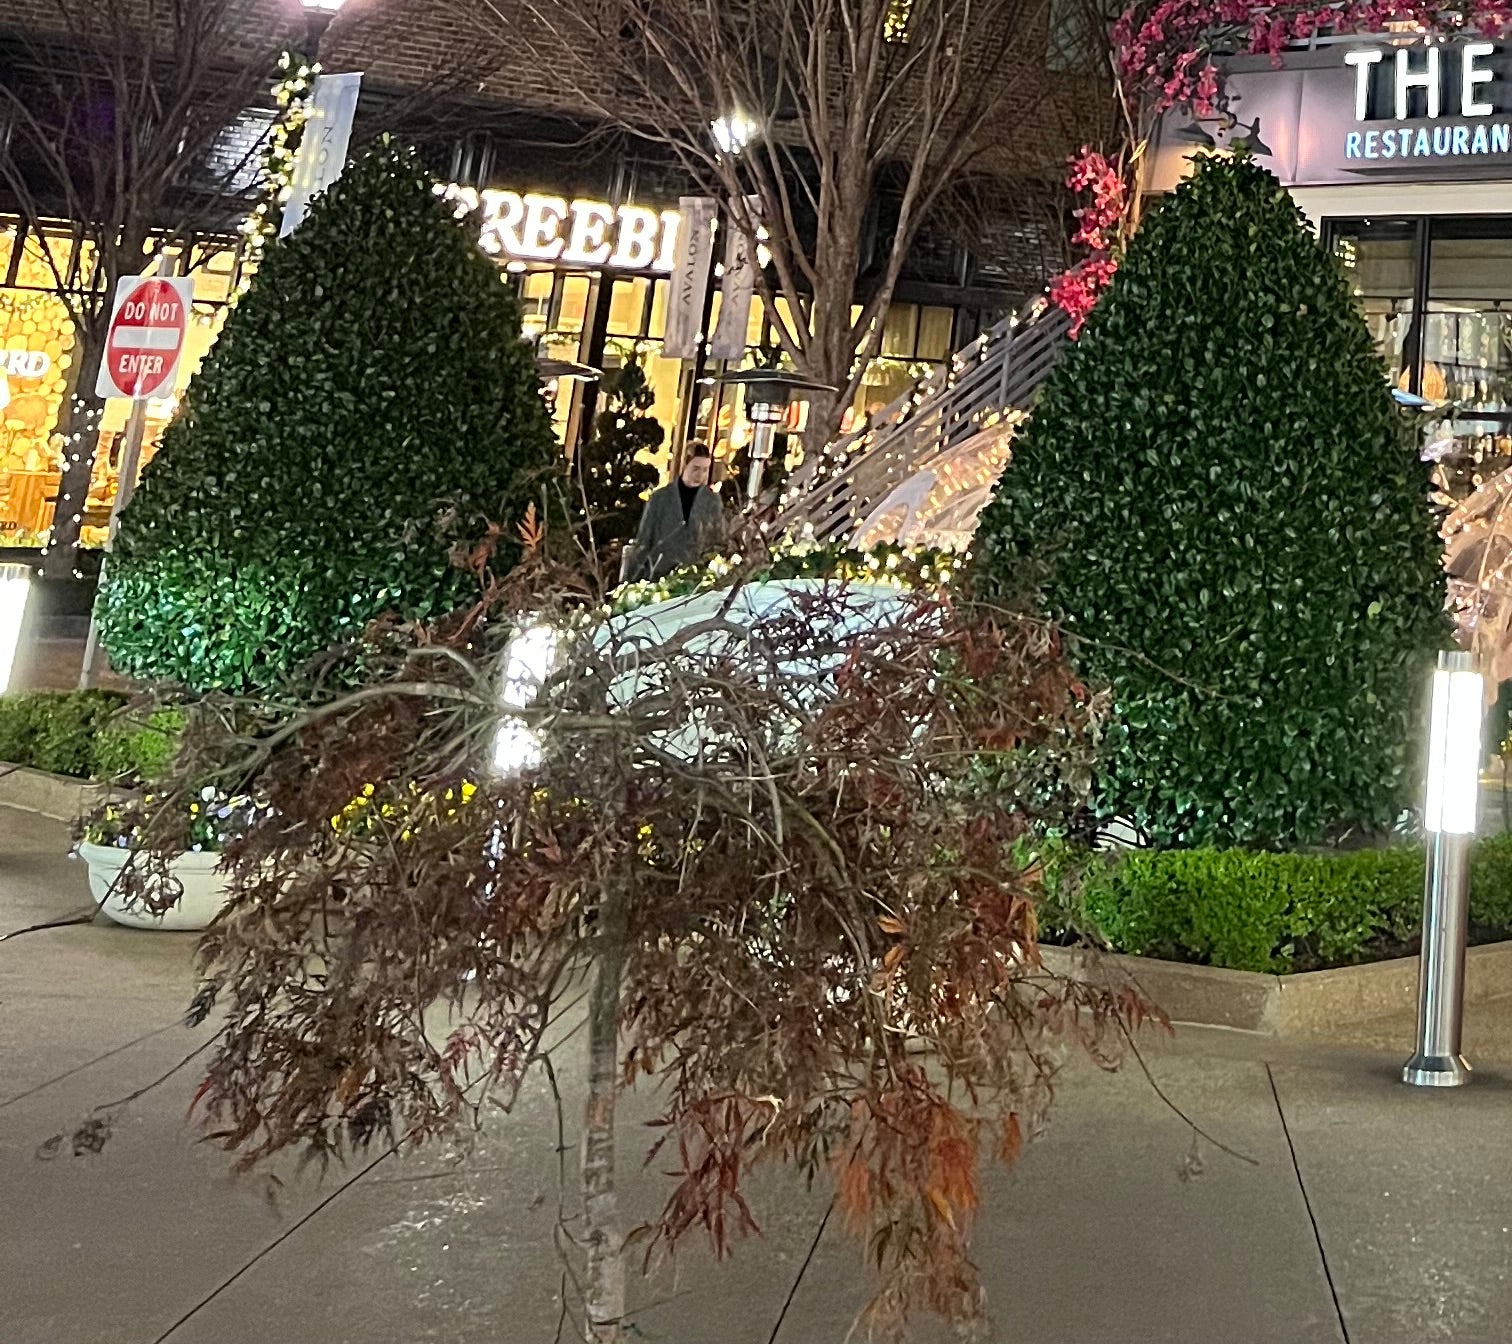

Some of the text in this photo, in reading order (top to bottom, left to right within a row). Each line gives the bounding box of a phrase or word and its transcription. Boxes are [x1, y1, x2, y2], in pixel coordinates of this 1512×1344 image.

[1345, 42, 1494, 121] THE
[433, 183, 681, 272] REEBI
[681, 229, 700, 306] AVALON
[124, 301, 179, 321] DO NOT
[118, 354, 164, 374] ENTER
